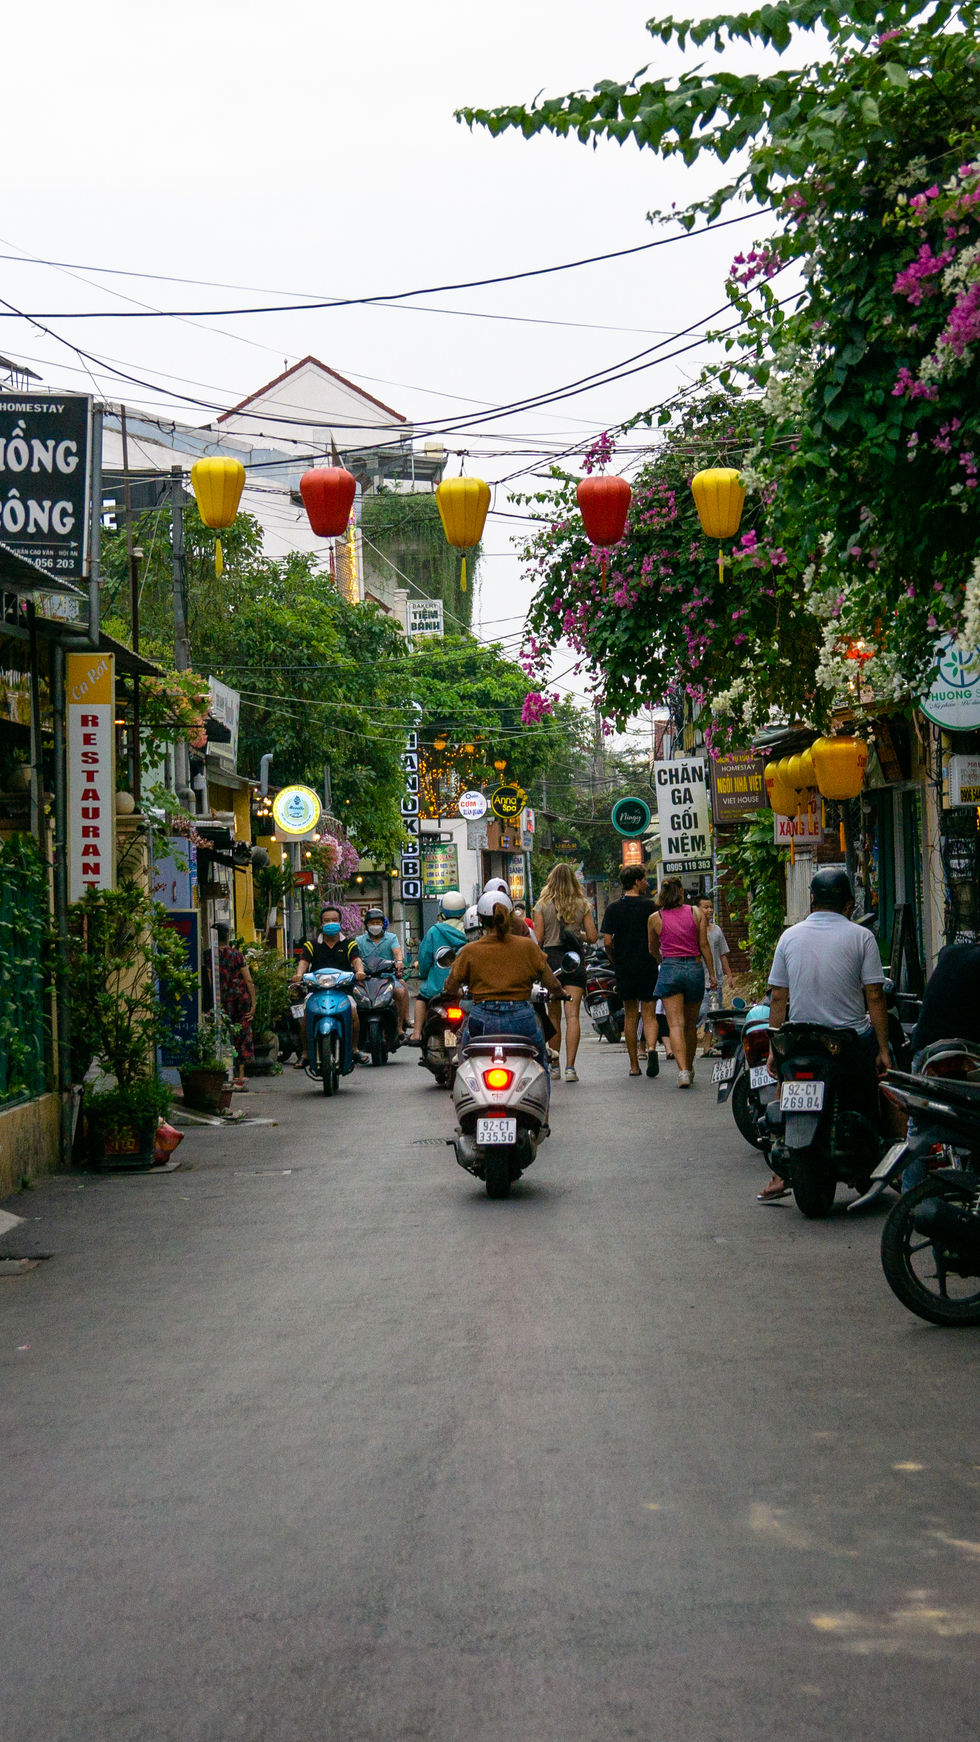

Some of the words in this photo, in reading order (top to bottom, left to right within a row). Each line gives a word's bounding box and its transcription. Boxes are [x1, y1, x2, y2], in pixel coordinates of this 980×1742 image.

[0, 402, 65, 415] HOMESTAY
[0, 488, 75, 535] ÔNG
[56, 558, 75, 569] 203
[410, 620, 440, 631] BÁNH
[930, 689, 972, 702] HUONG
[721, 763, 756, 772] HOMESTAY
[657, 763, 704, 786] CHĂN
[80, 714, 101, 892] RESTAURANT
[494, 795, 517, 805] Anna
[671, 788, 694, 806] GA
[722, 797, 736, 805] VIET
[737, 796, 759, 804] HOUSE
[502, 804, 517, 813] Spa
[670, 807, 699, 831] GỐI
[667, 832, 706, 857] NỆM
[666, 862, 683, 873] 0905
[788, 1084, 817, 1096] 92-C1
[783, 1096, 820, 1109] 269.84
[483, 1121, 510, 1131] 92-C1
[479, 1132, 514, 1142] 335.56
